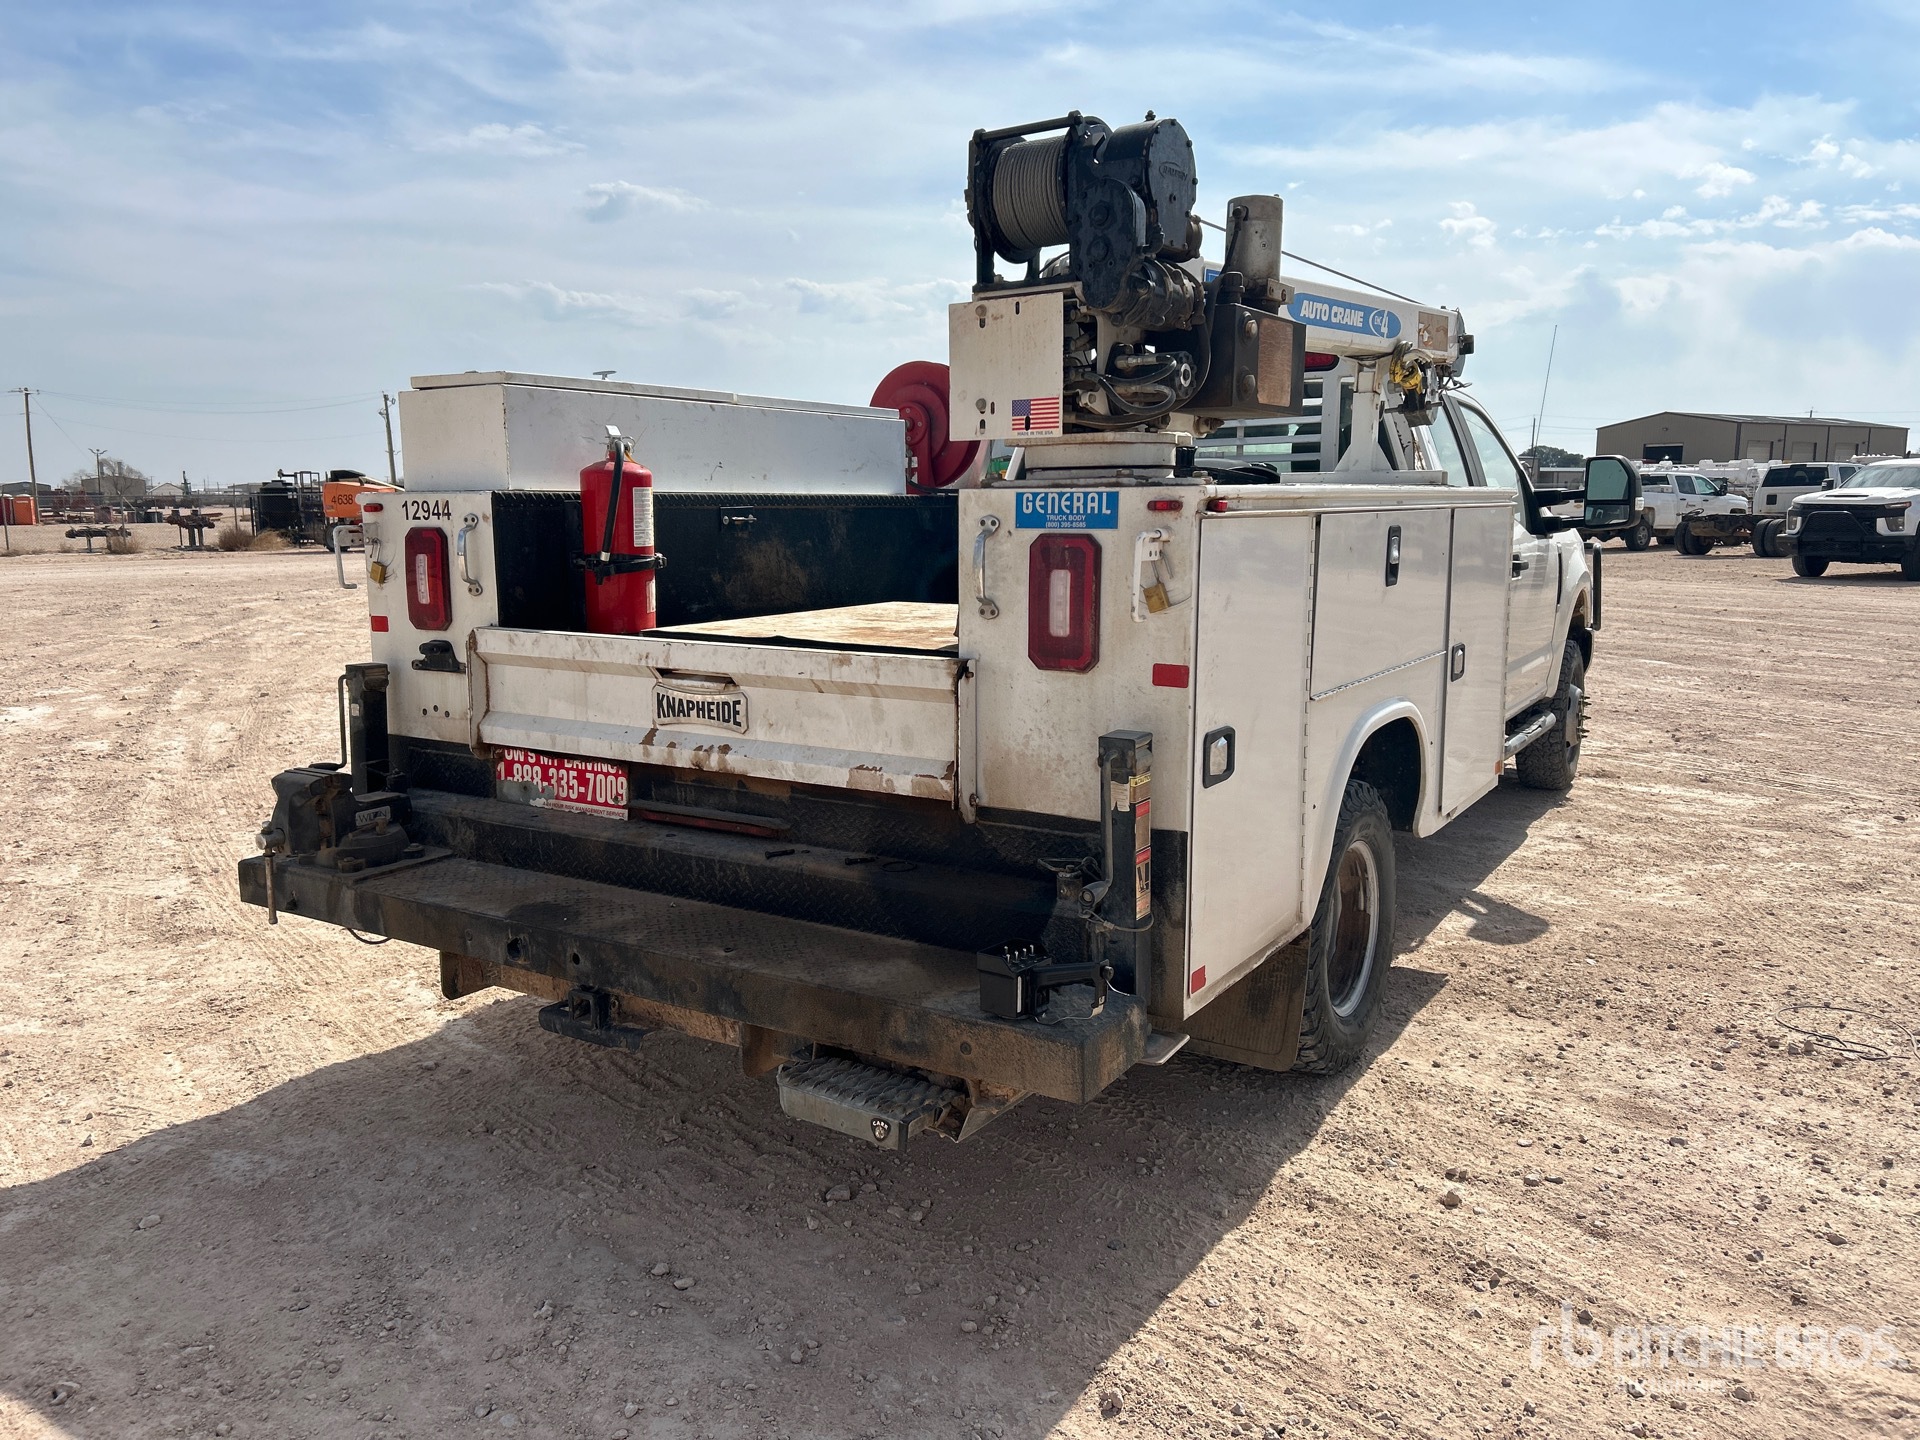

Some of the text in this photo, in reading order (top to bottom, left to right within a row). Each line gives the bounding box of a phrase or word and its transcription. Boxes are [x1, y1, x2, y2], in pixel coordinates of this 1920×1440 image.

[1300, 300, 1365, 328] AUTO CRANE
[402, 500, 452, 520] 12944
[1023, 492, 1112, 515] GENERAL
[1045, 521, 1060, 529] (800)
[656, 692, 742, 727] KNAPHEIDE
[497, 761, 628, 806] 1-888-335-7009
[575, 806, 606, 815] MANAGEMENT
[606, 810, 626, 818] SERVICE
